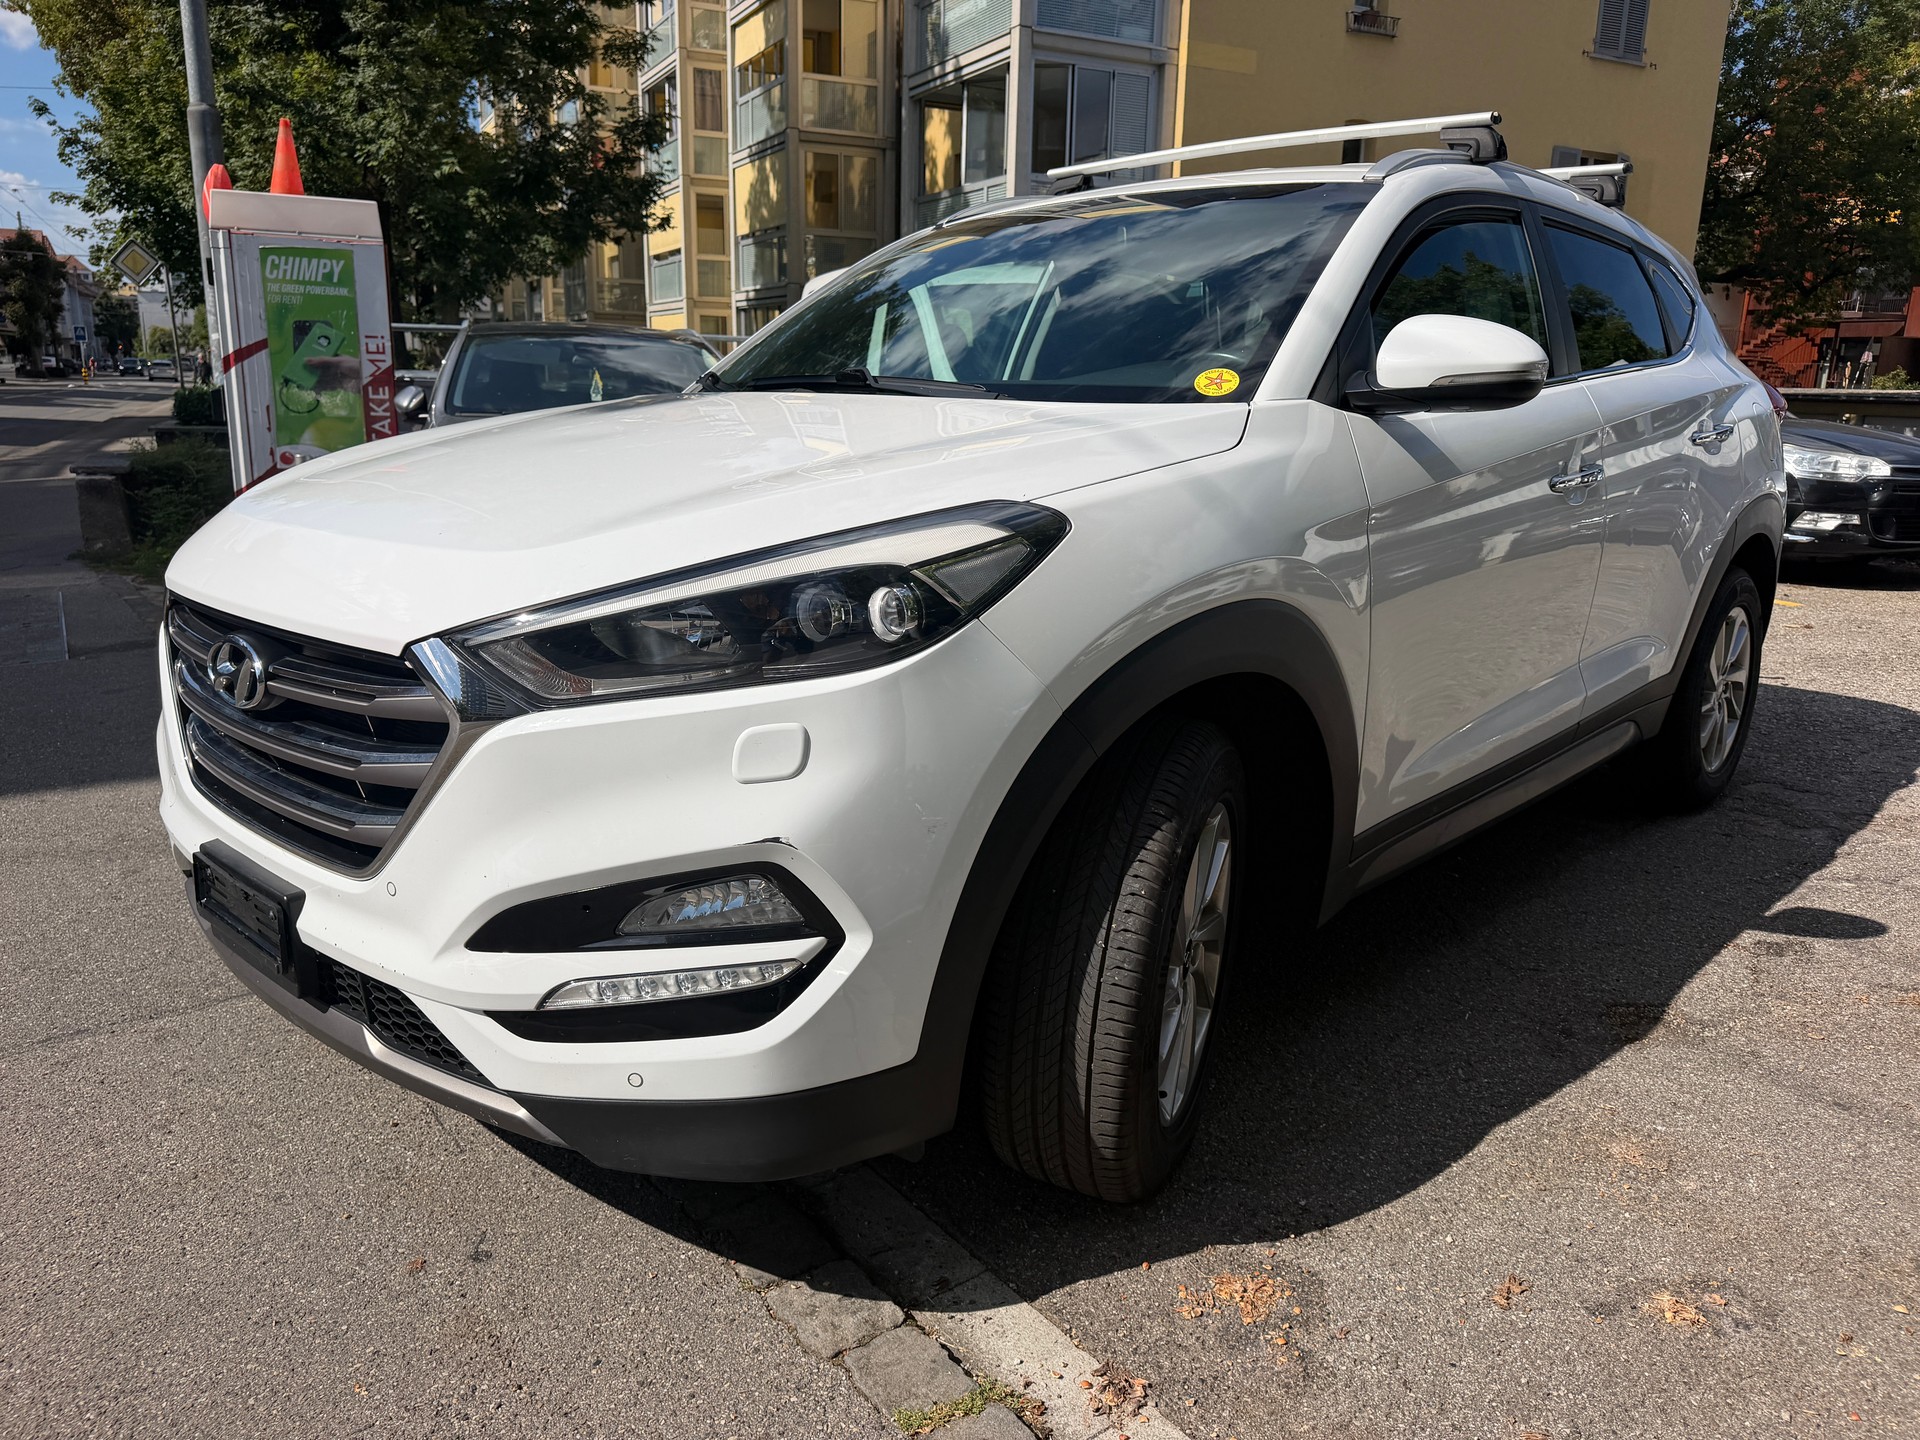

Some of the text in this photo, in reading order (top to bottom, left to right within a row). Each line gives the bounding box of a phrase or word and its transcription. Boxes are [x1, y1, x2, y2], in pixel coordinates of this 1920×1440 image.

[265, 254, 345, 283] CHIMPY
[267, 283, 281, 293] THE
[281, 283, 305, 294] GREEN
[267, 294, 282, 304] FOR
[364, 335, 387, 378] ME!
